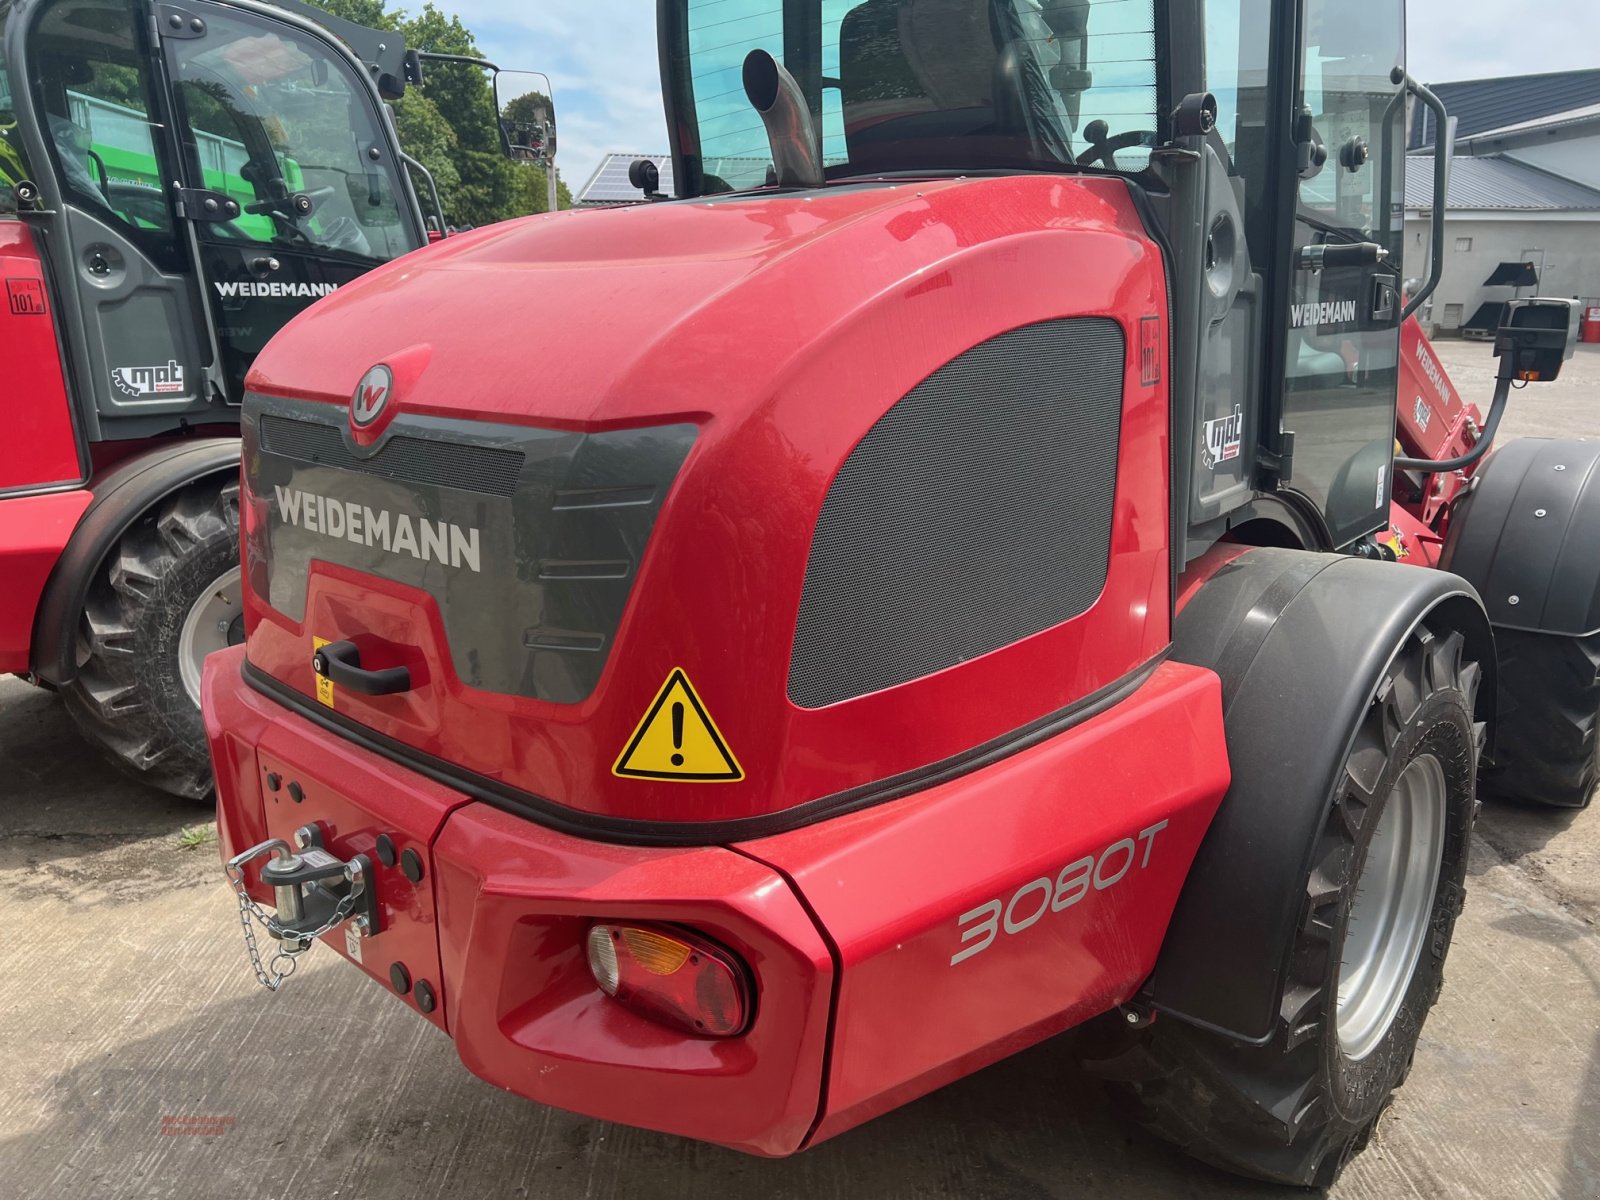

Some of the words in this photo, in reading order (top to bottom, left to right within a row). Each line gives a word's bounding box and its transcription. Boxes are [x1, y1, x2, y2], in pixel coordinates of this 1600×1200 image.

[13, 294, 34, 311] 101
[214, 282, 338, 297] WEIDEMANN
[1291, 300, 1356, 327] WEIDEMANN
[1416, 339, 1450, 406] WEIDEMANN
[274, 484, 480, 573] WEIDEMANN
[950, 819, 1169, 966] 3080T
